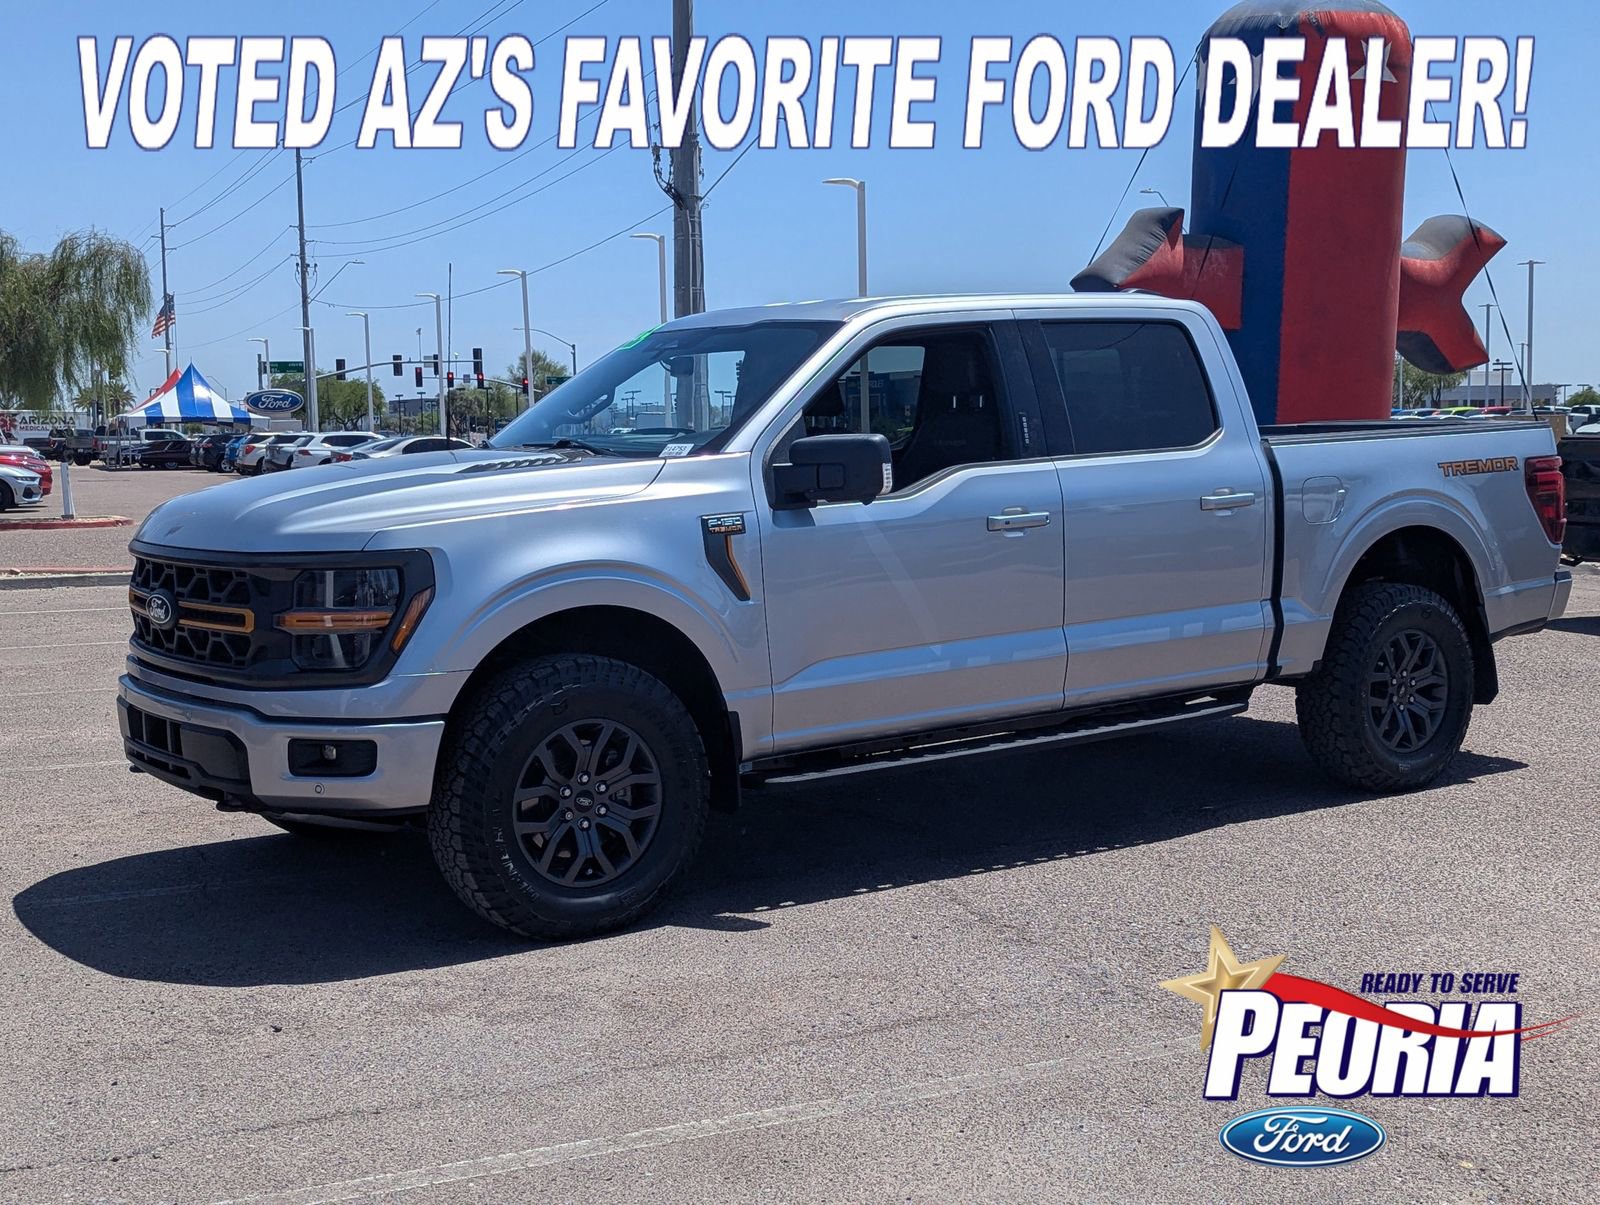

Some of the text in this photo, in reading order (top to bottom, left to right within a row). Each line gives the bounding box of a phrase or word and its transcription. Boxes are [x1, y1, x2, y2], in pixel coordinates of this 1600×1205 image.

[258, 394, 292, 409] Ford
[19, 415, 76, 425] ARIZONA
[1437, 456, 1520, 477] TREMOR
[150, 598, 166, 619] Ford
